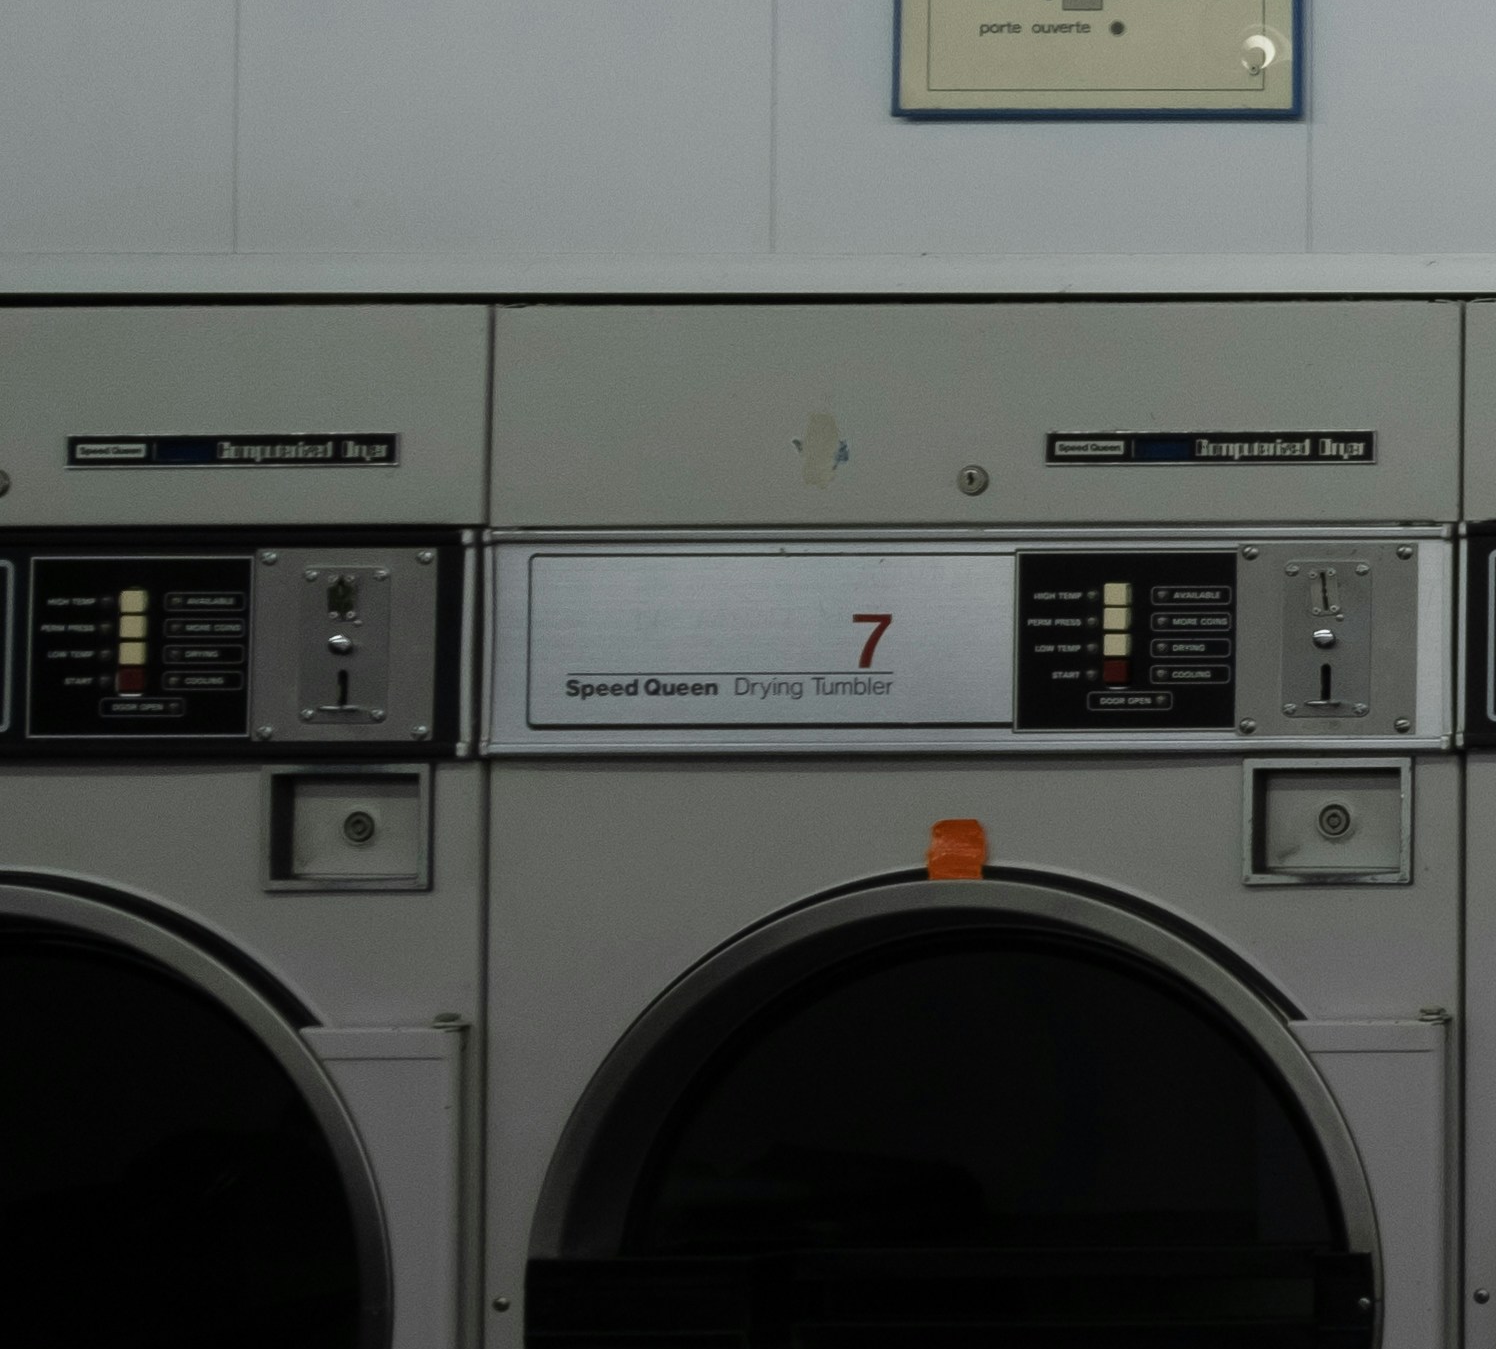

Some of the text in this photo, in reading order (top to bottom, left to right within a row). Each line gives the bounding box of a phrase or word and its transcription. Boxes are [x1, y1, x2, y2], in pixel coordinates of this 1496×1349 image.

[979, 22, 1090, 37] porte ouverte
[852, 614, 892, 668] 7
[566, 678, 893, 699] Speed Queen Drying Tumbler
